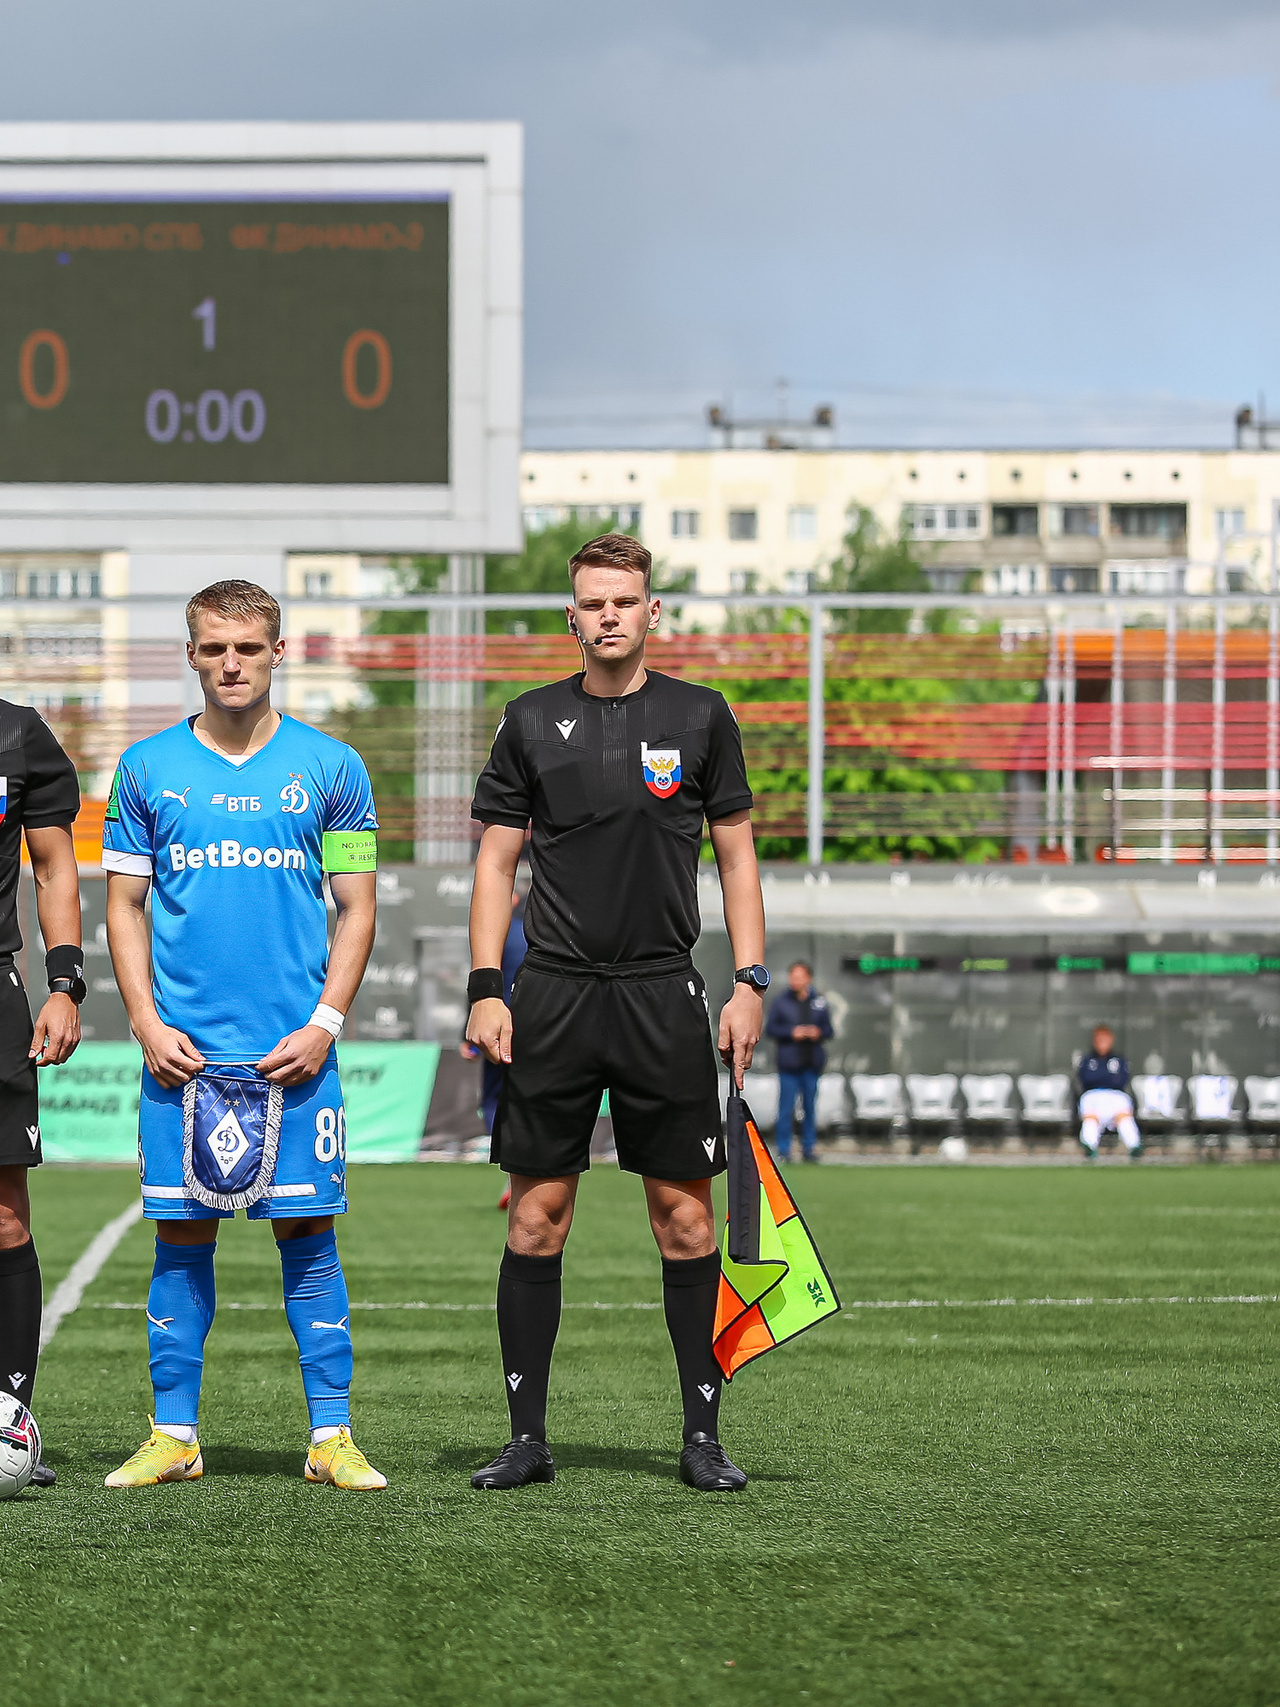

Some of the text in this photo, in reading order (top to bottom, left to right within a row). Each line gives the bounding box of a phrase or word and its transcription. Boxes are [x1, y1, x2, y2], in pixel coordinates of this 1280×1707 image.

[192, 297, 217, 352] 1
[20, 328, 70, 409] 0
[342, 328, 393, 409] 0
[145, 389, 267, 442] 0:00
[227, 796, 262, 812] ВТБ
[169, 839, 306, 872] BetBoom
